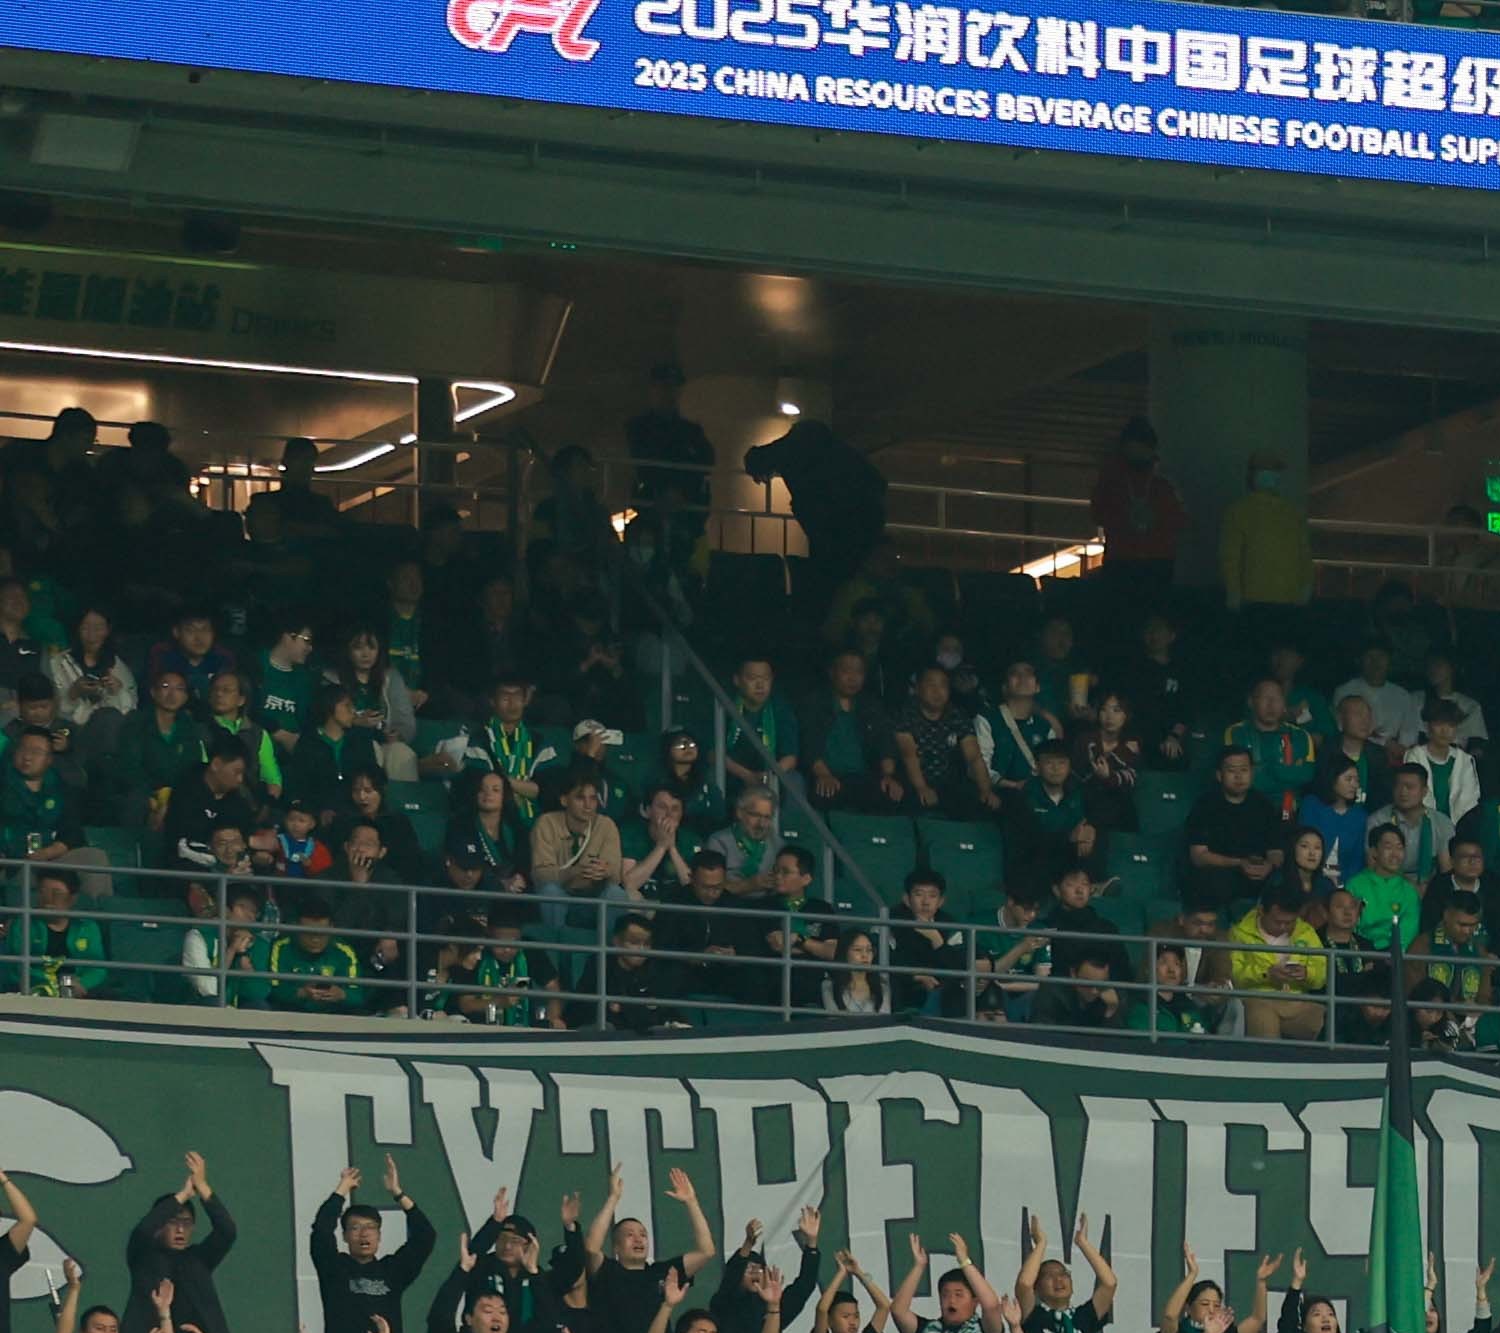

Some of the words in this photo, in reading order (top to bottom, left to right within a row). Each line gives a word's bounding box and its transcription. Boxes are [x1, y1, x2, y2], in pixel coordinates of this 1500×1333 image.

[633, 57, 707, 92] 2025
[712, 69, 811, 103] CHINA
[814, 74, 991, 121] RESOURCES
[995, 99, 1153, 137] BEVERAGE
[1156, 106, 1281, 148] CHINESE
[1284, 117, 1435, 162] FOOTBALL
